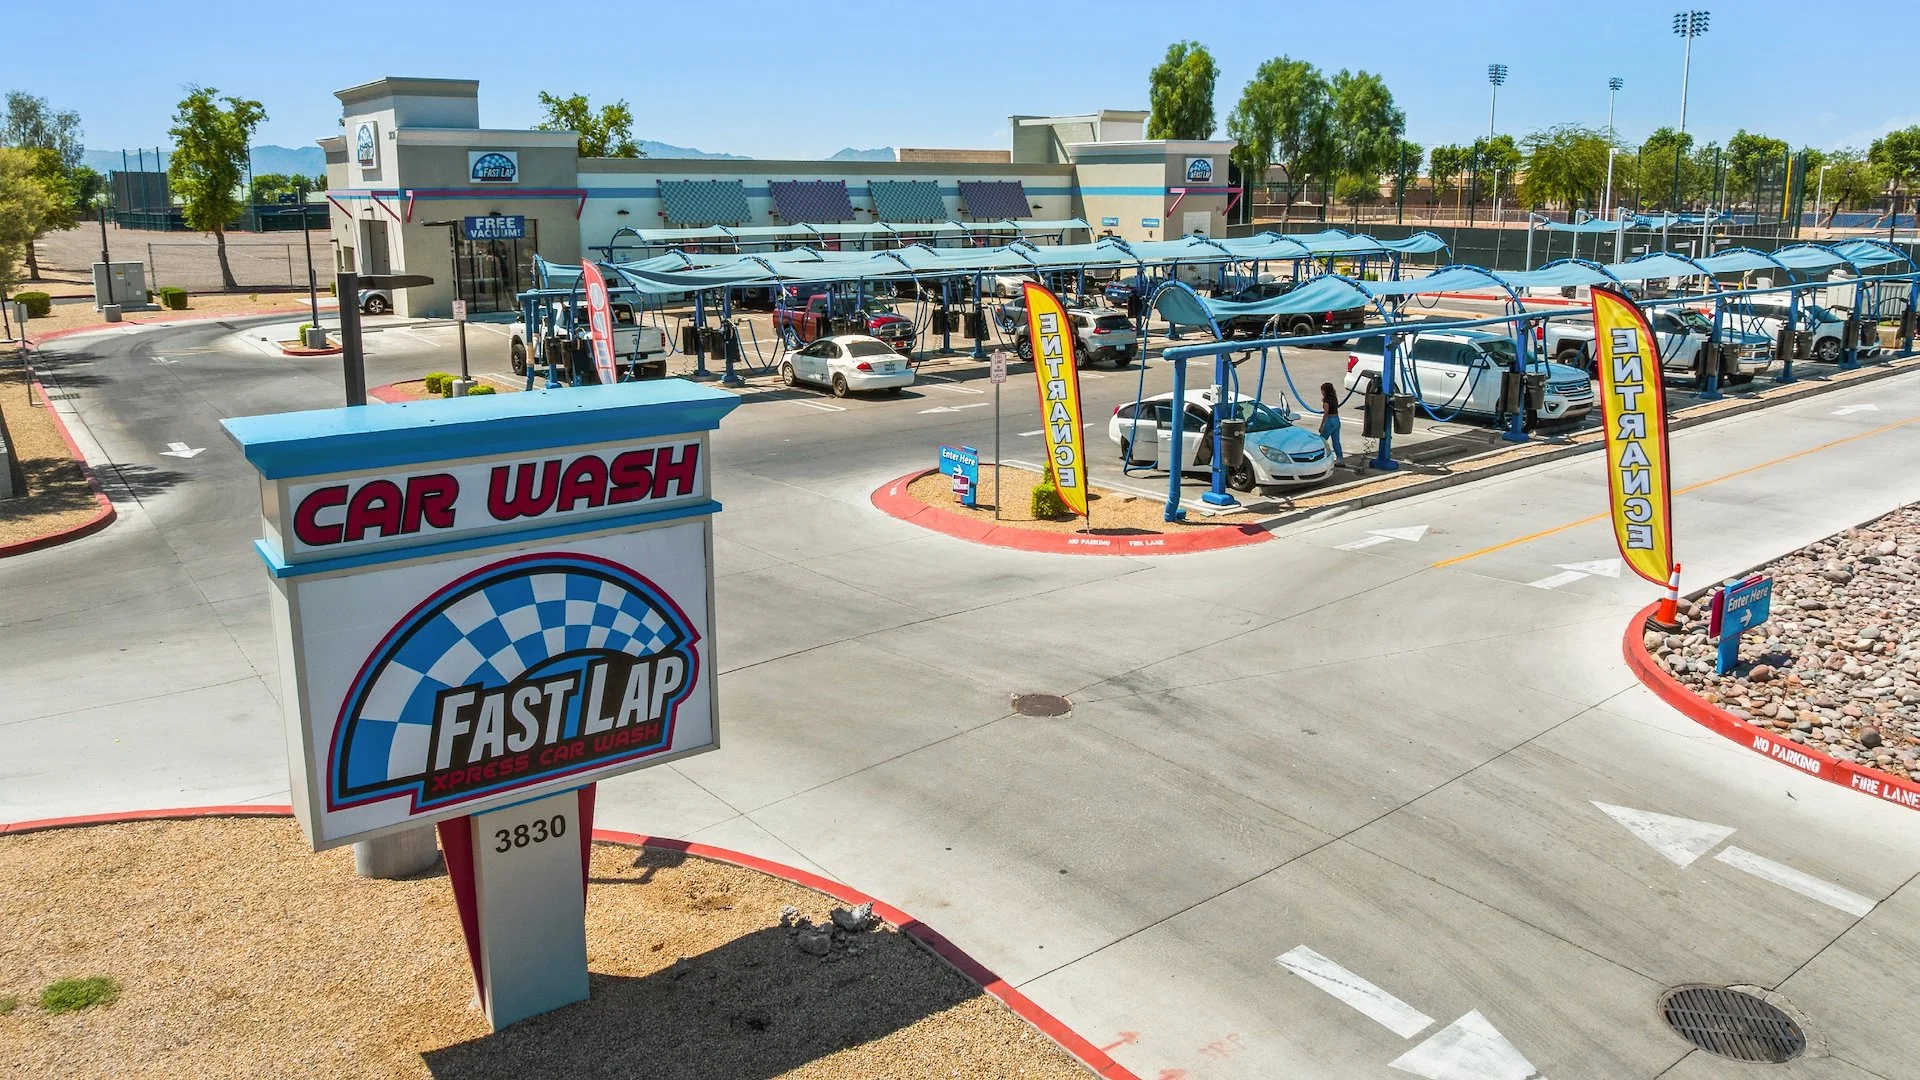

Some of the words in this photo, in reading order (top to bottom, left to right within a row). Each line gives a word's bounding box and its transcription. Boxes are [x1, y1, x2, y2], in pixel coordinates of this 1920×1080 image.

[484, 168, 500, 177] FAST
[501, 168, 514, 177] LAP
[470, 229, 520, 237] VACUUM!
[476, 218, 516, 229] FREE
[942, 448, 959, 461] Enter
[960, 453, 976, 467] Here
[293, 473, 460, 547] CAR
[487, 443, 700, 521] WASH
[1727, 595, 1750, 613] Enter
[1750, 587, 1769, 602] Here
[434, 677, 575, 772] FAST
[585, 656, 684, 736] LAP
[431, 752, 530, 793] XPRESS
[540, 741, 585, 766] CAR
[593, 722, 660, 752] WASH
[1753, 735, 1769, 752] NO
[1771, 743, 1820, 773] PARKING
[1852, 774, 1880, 795] FIRE
[1883, 784, 1920, 808] LANE
[495, 814, 566, 853] 3830
